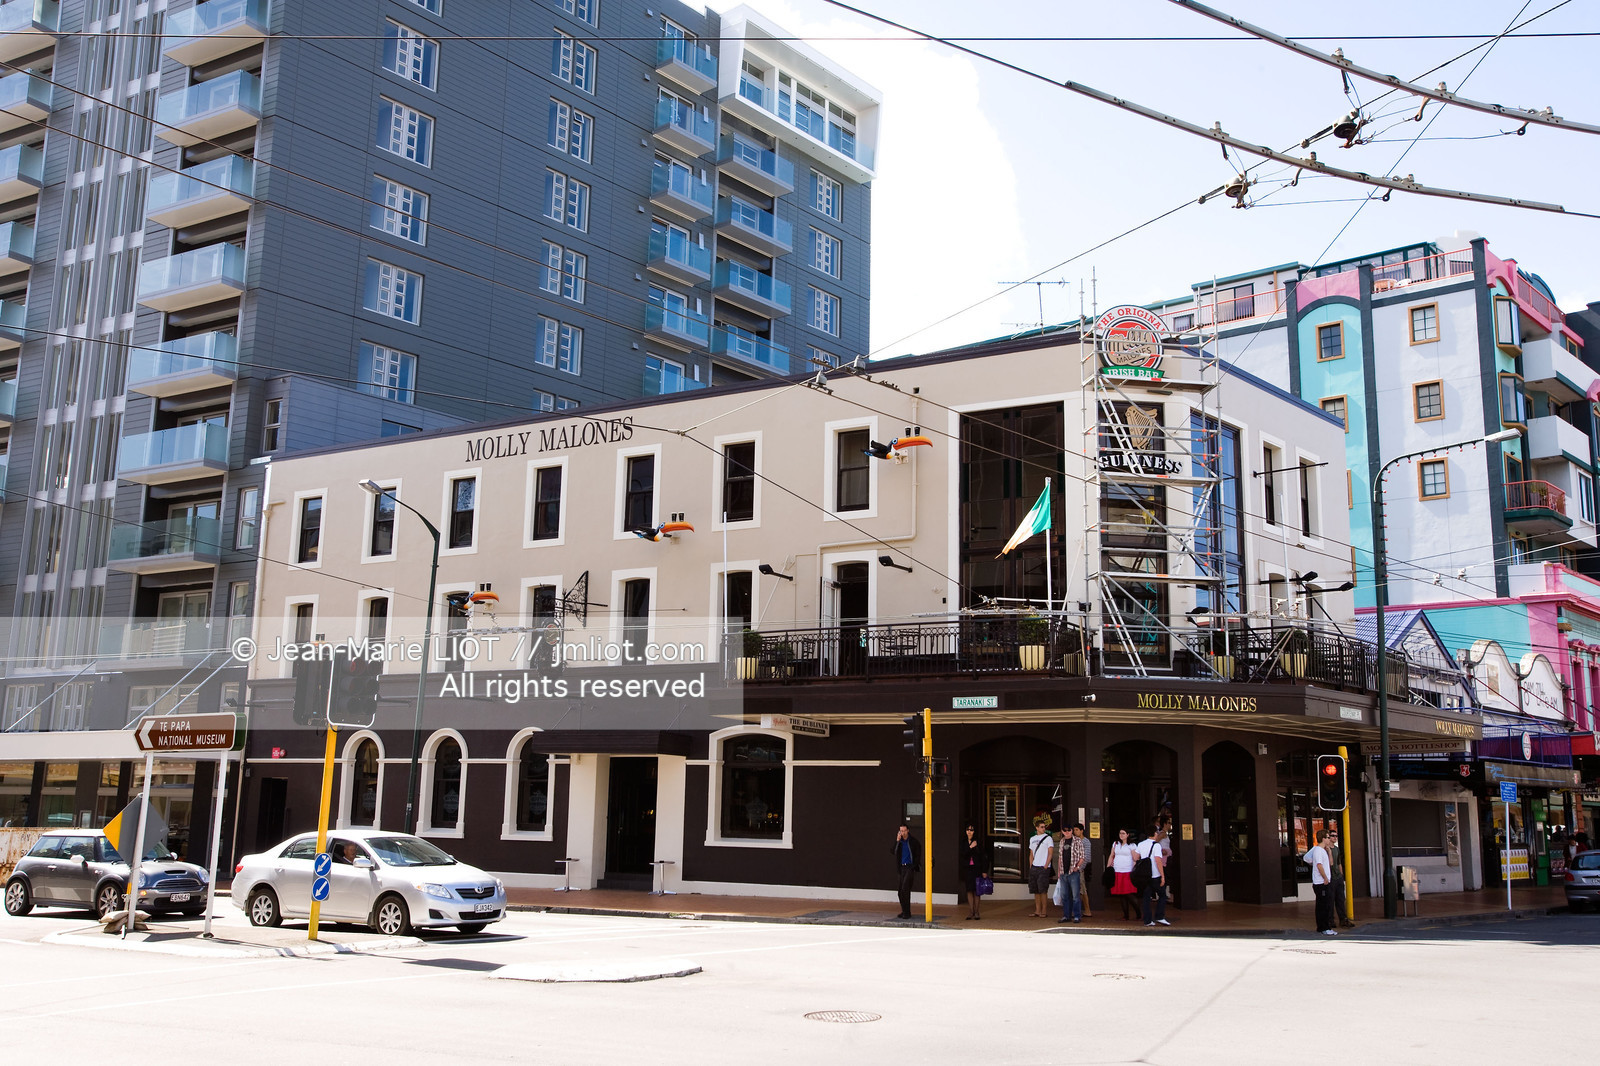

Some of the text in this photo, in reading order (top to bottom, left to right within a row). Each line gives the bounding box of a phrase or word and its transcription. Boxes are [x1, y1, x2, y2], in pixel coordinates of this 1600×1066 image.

[1107, 368, 1159, 378] IRISH BAR
[465, 416, 633, 462] MOLLY MALONES
[1137, 693, 1257, 712] MOLLY MALONES
[160, 720, 191, 732] TE PAPA
[158, 733, 226, 746] NATIONAL MUSEUM
